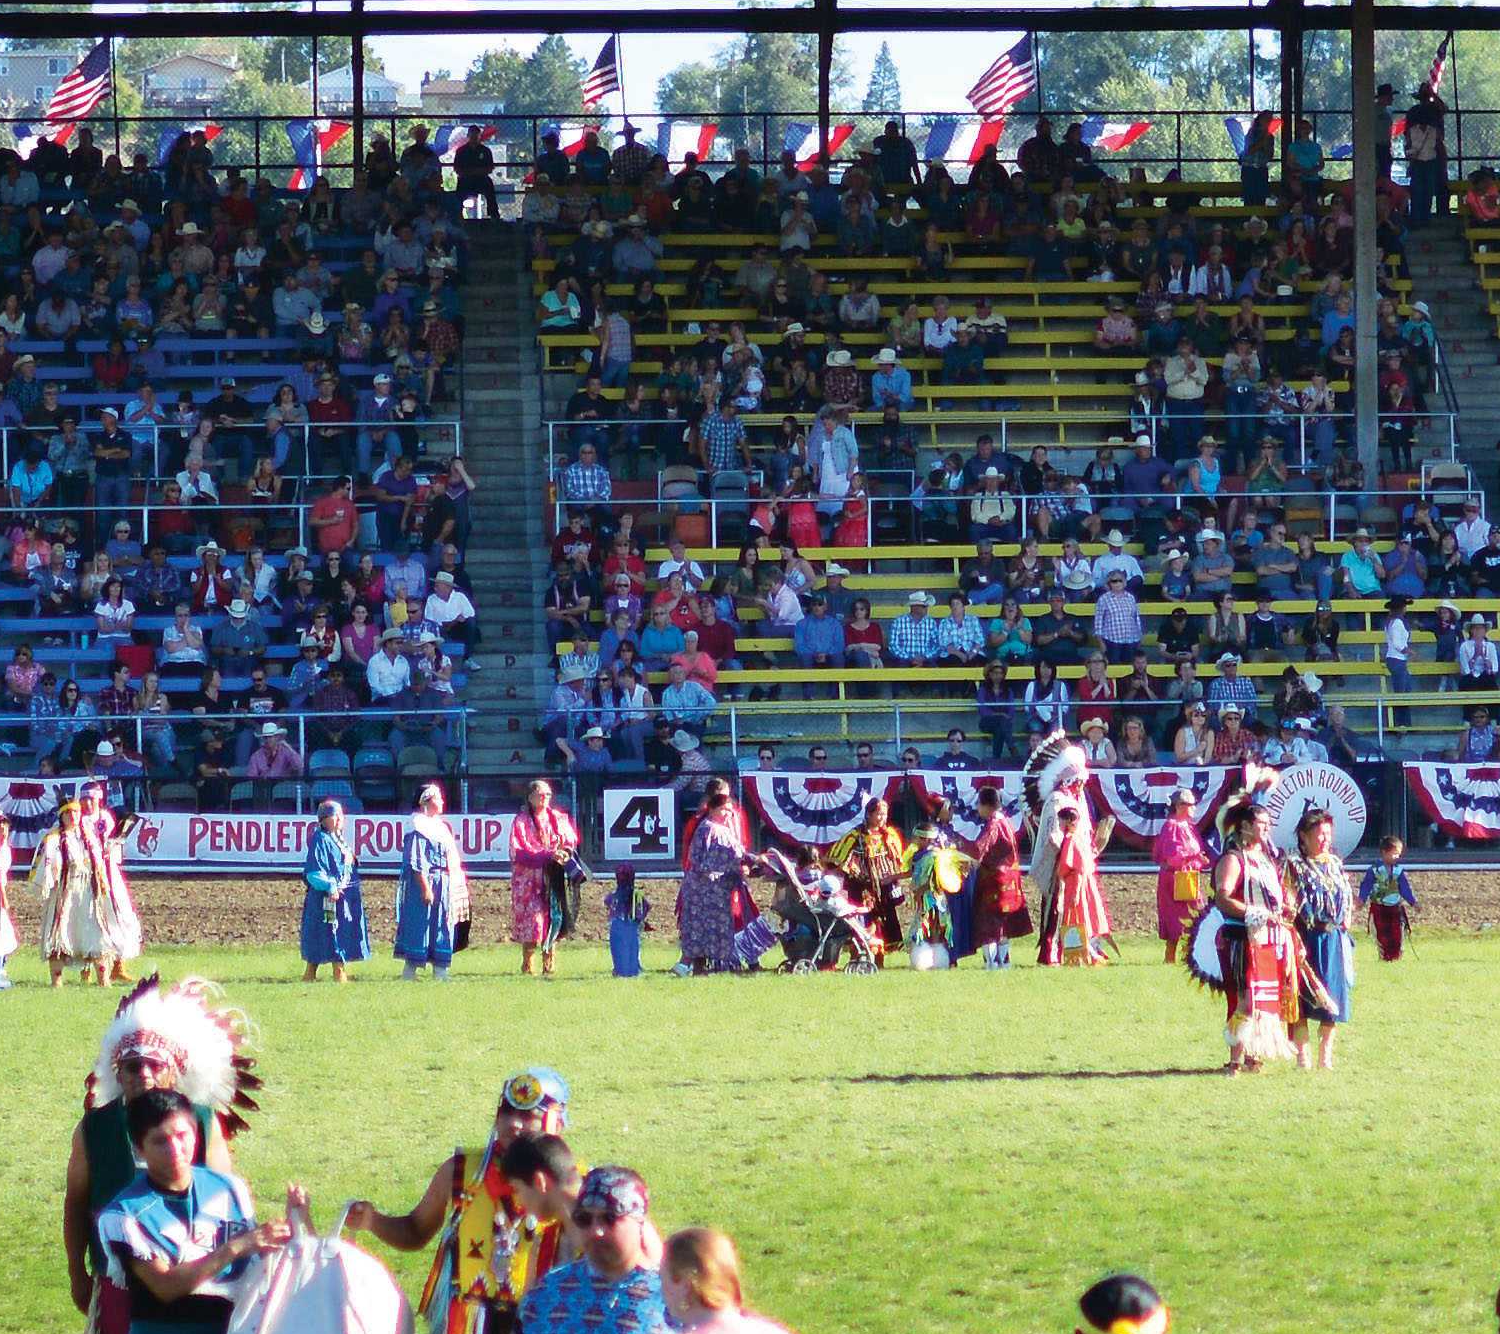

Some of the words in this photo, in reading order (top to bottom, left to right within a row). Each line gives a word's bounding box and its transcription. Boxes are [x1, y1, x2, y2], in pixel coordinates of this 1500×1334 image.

[1318, 769, 1365, 824] ROUND-UP
[188, 817, 319, 858] PENDLET
[354, 818, 502, 857] RO-UP
[609, 795, 669, 854] 4
